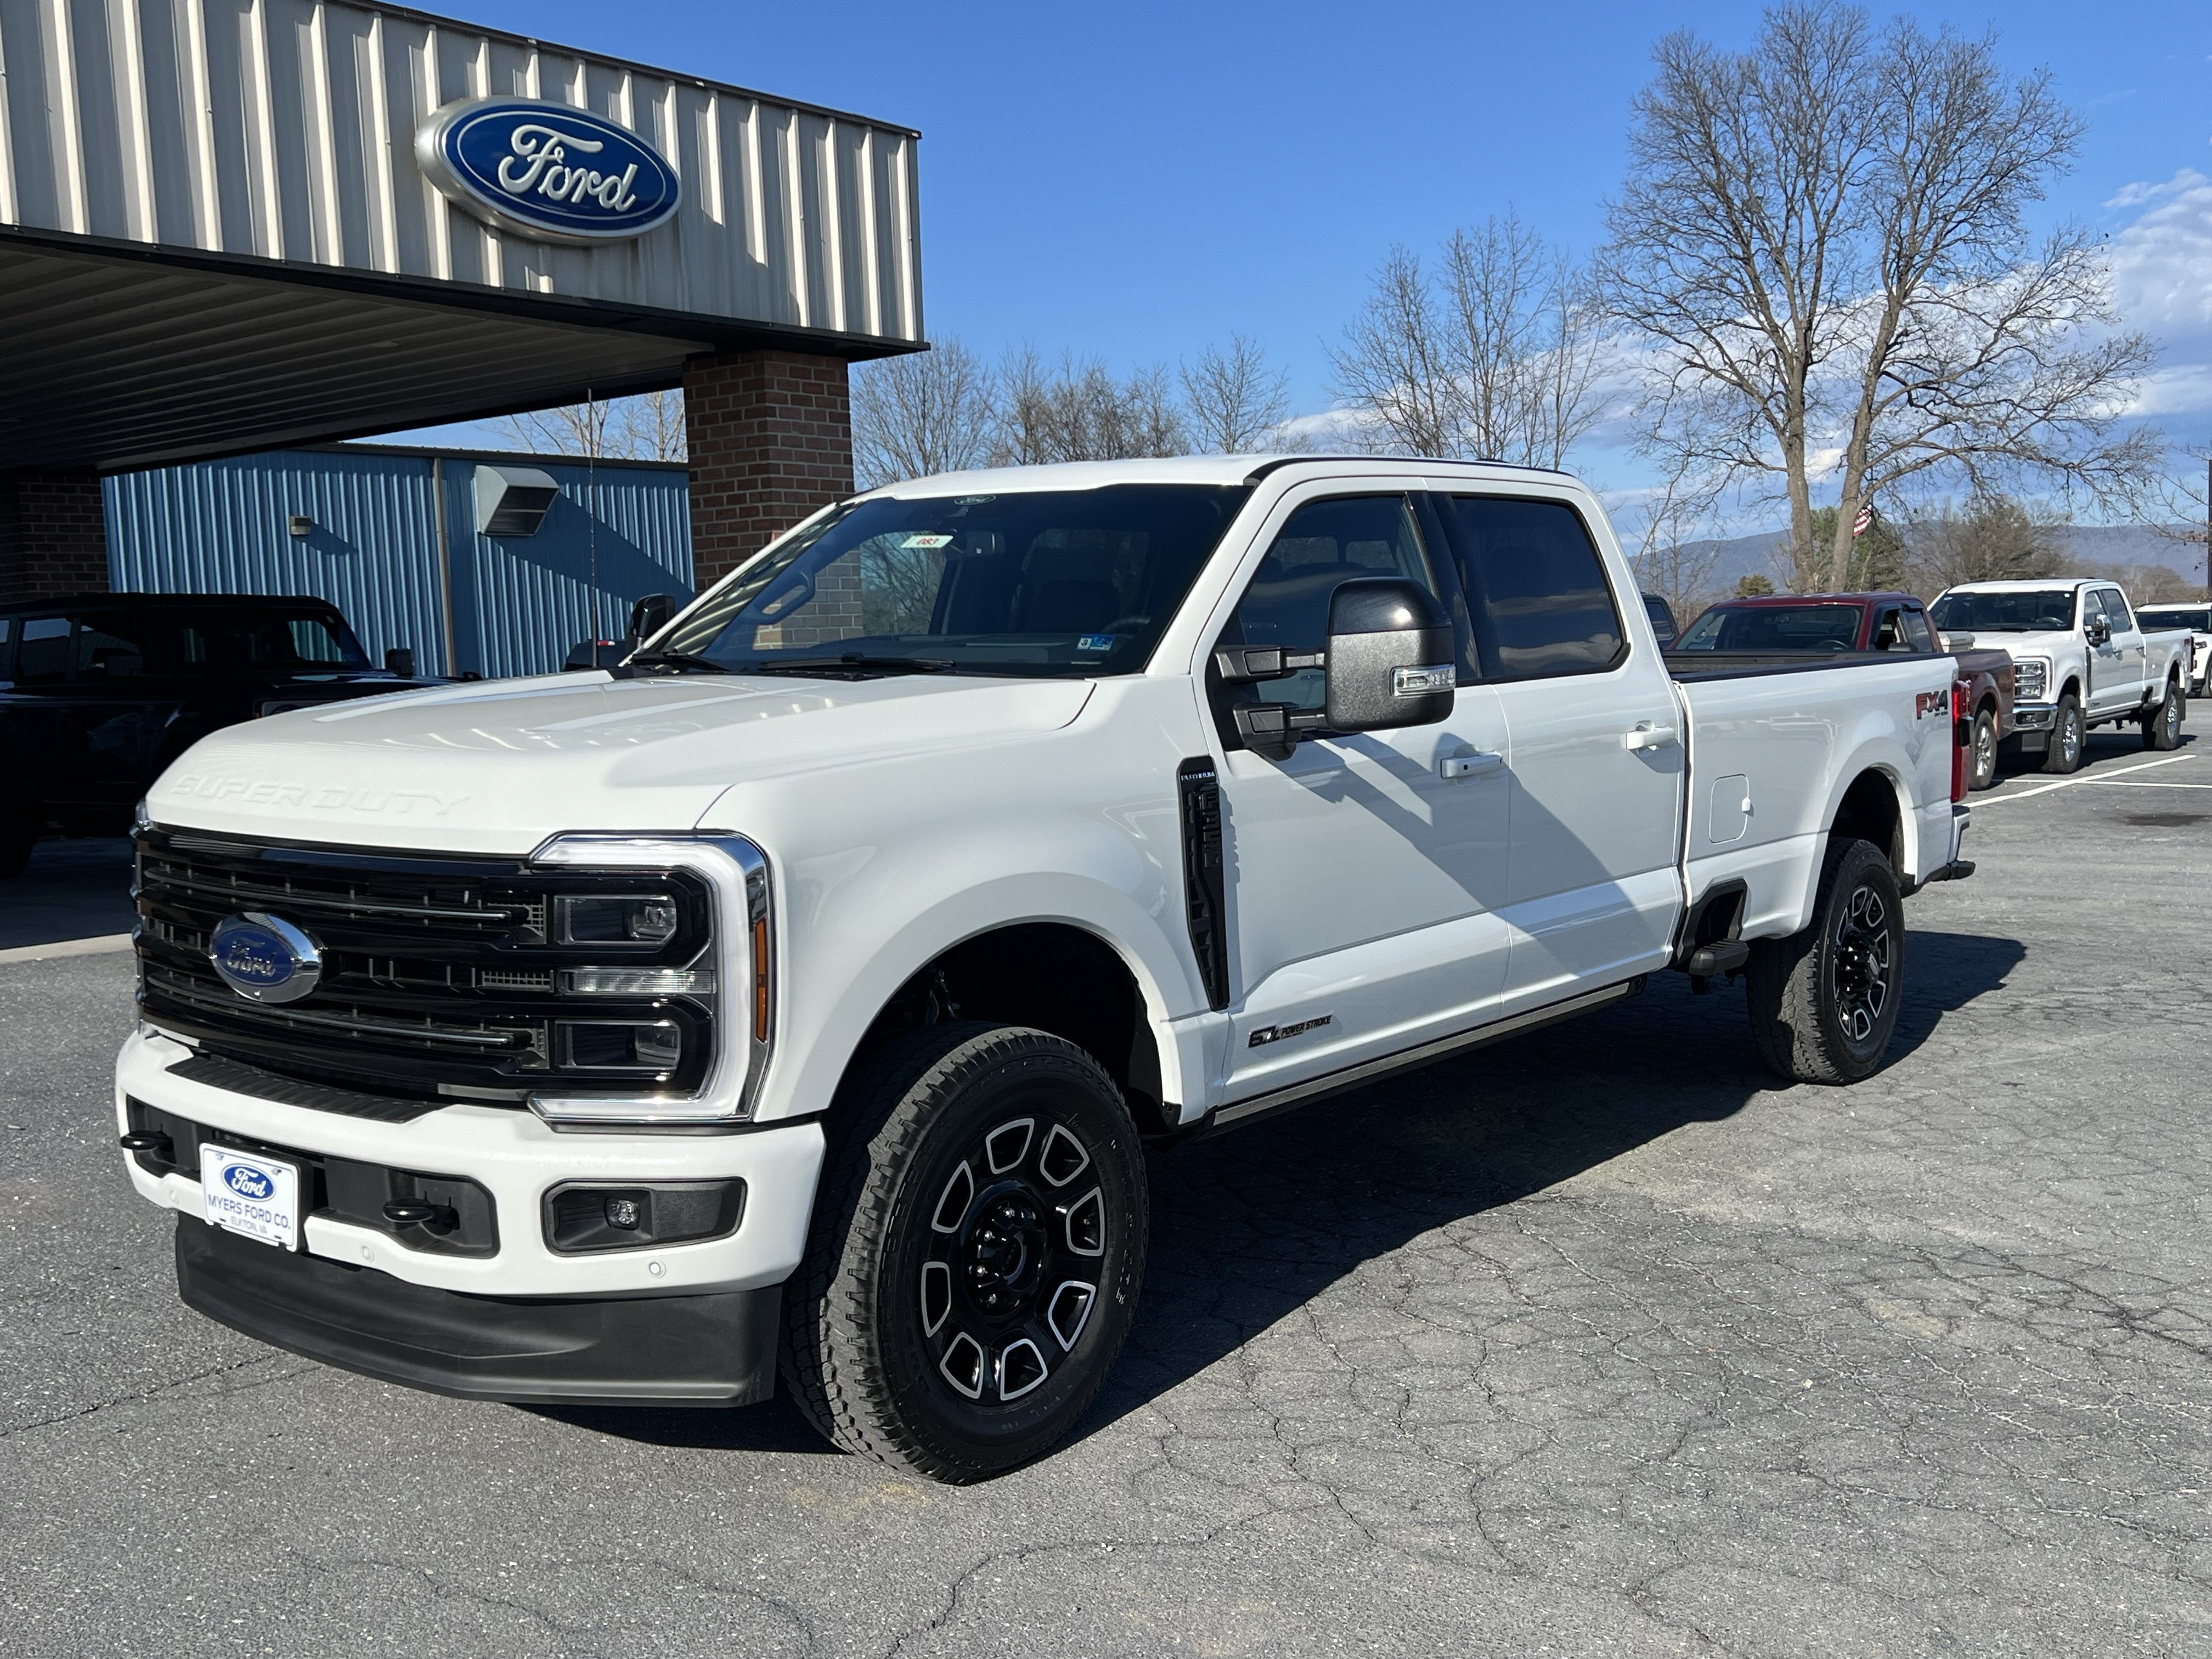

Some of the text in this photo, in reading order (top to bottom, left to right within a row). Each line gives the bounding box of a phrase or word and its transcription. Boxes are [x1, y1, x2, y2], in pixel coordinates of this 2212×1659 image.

[498, 123, 639, 212] Ford
[1915, 690, 1948, 720] FX4
[173, 774, 472, 816] SUPER DUTY
[227, 936, 276, 978] Ford
[1282, 1023, 1305, 1036] POWER
[1305, 1014, 1332, 1030] STROKE
[231, 1167, 266, 1197] Ford
[208, 1193, 291, 1230] MYERS FORD CO.
